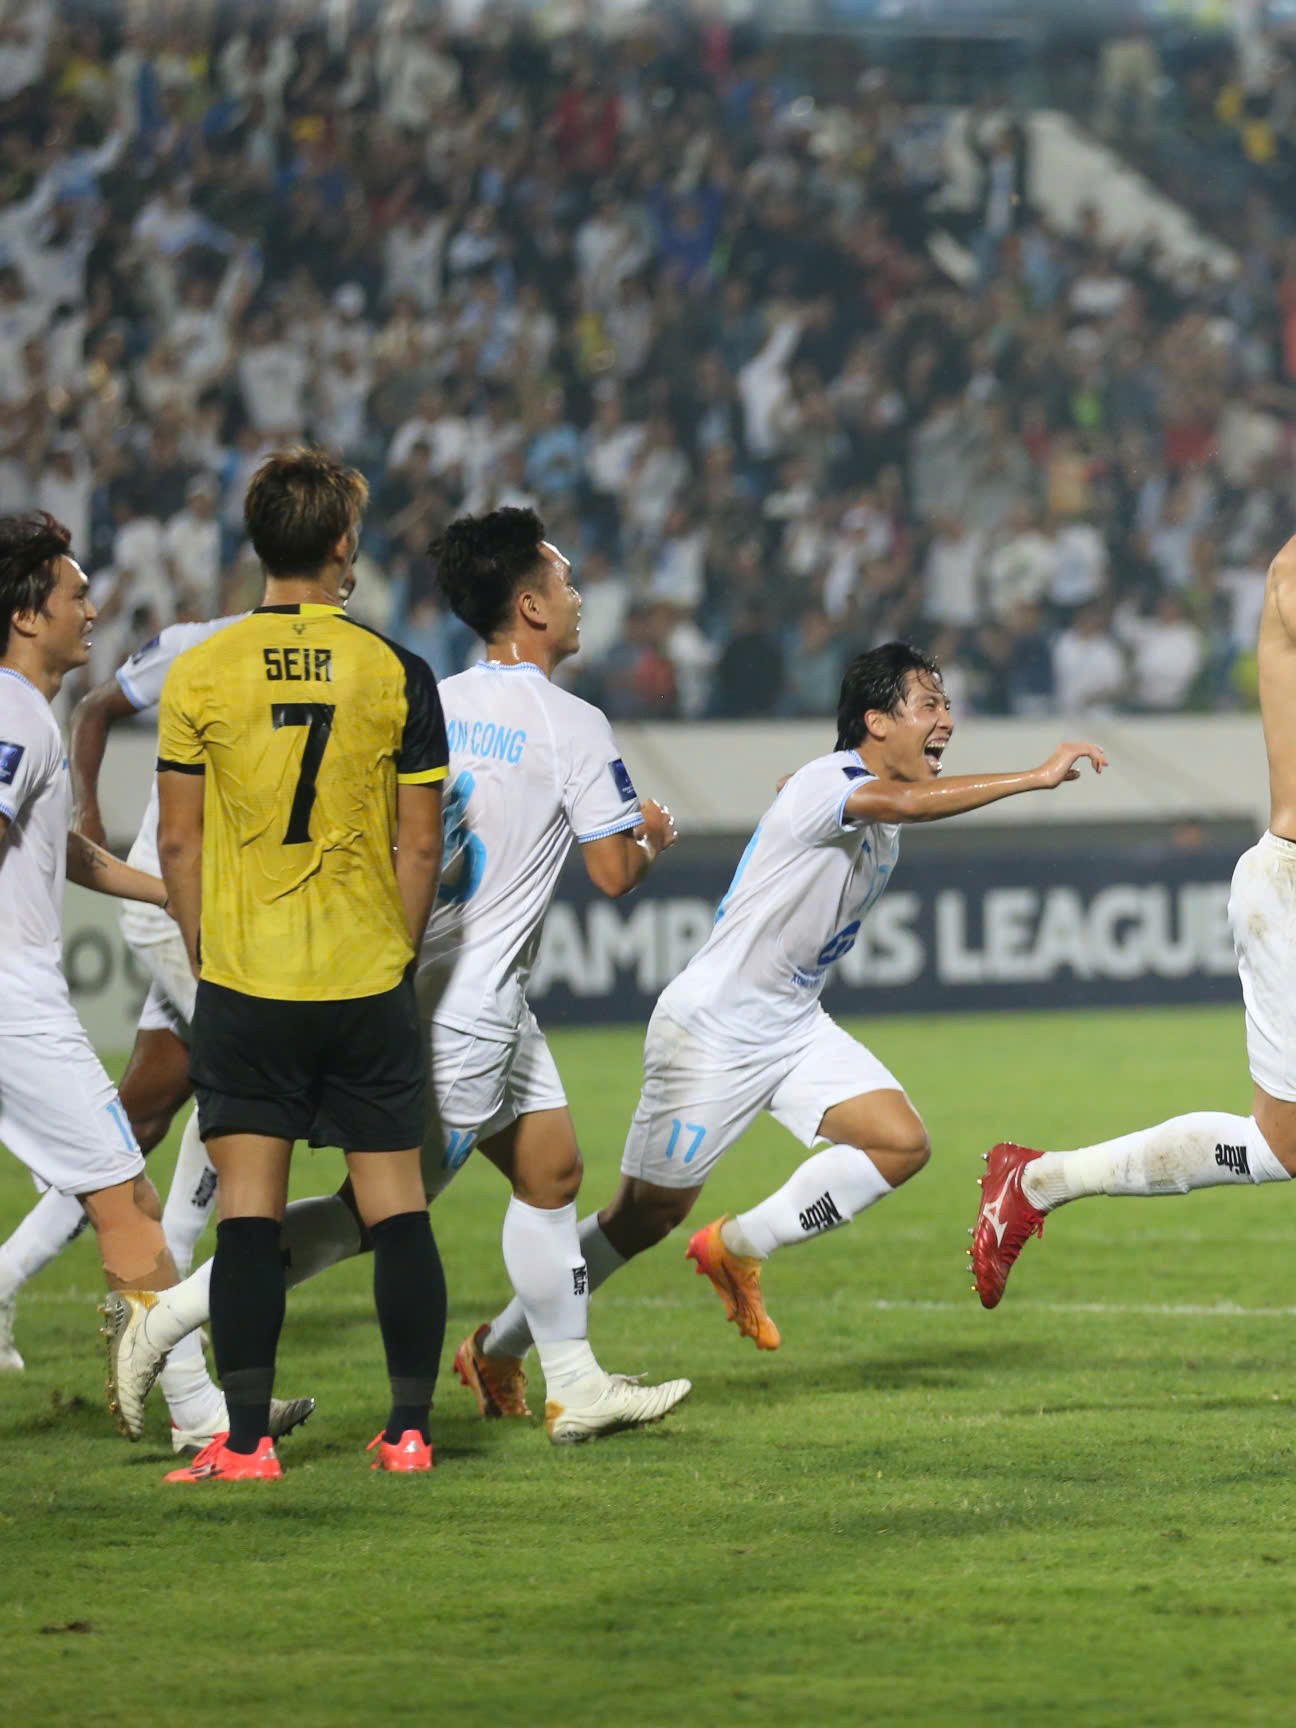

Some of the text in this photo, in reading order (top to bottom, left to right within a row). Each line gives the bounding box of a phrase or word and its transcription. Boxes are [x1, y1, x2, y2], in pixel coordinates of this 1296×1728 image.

[263, 647, 332, 682] SEIR
[447, 719, 527, 764] AN CONG
[271, 702, 336, 845] 7
[665, 1118, 706, 1164] 17
[1215, 1143, 1251, 1175] Mitre
[799, 1192, 842, 1231] Mitre
